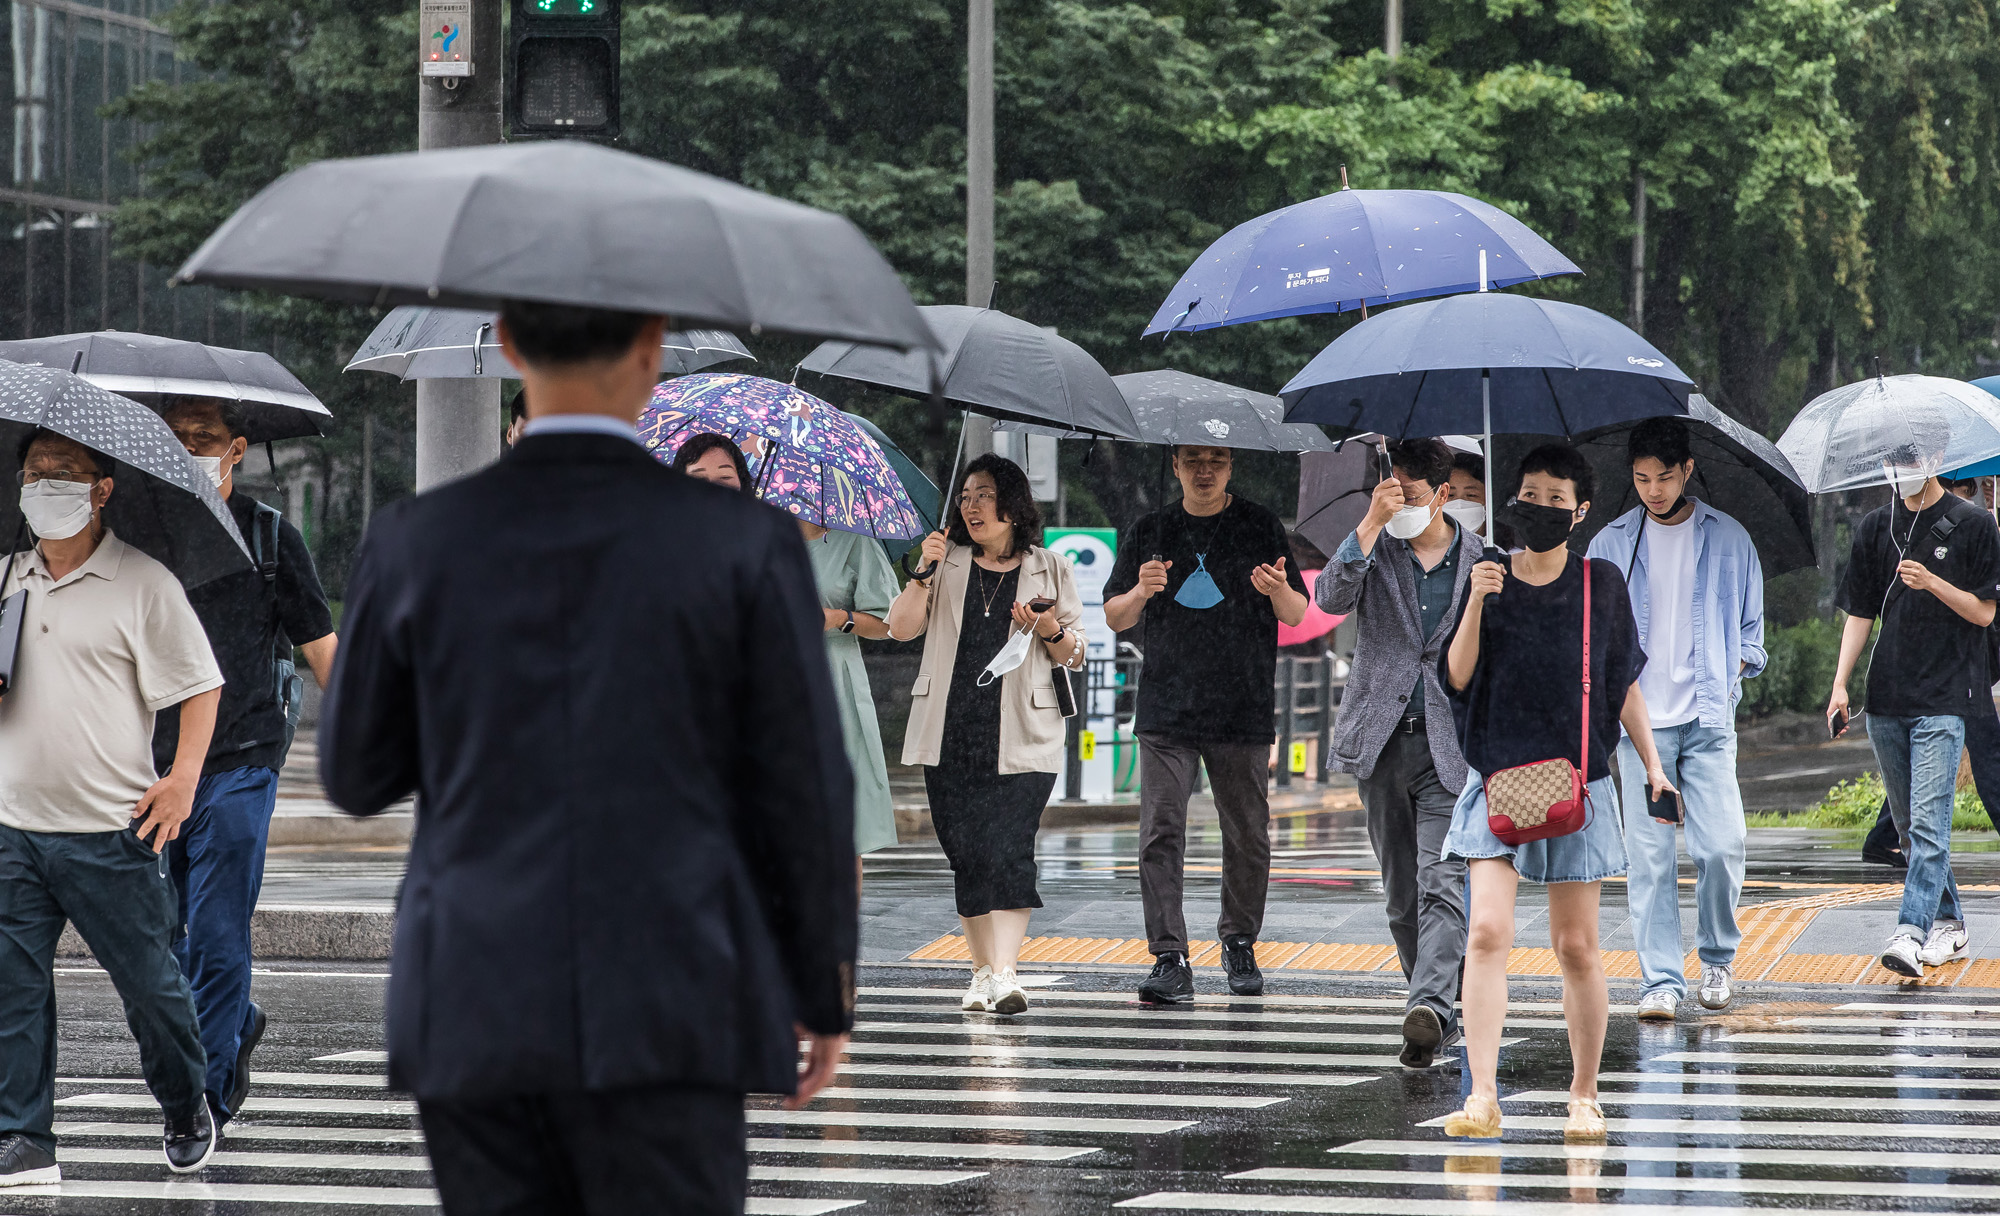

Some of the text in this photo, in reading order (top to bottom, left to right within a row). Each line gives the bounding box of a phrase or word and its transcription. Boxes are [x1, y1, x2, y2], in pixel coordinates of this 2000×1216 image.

[1288, 272, 1301, 280] 투자
[1292, 275, 1329, 288] 문화가 되다
